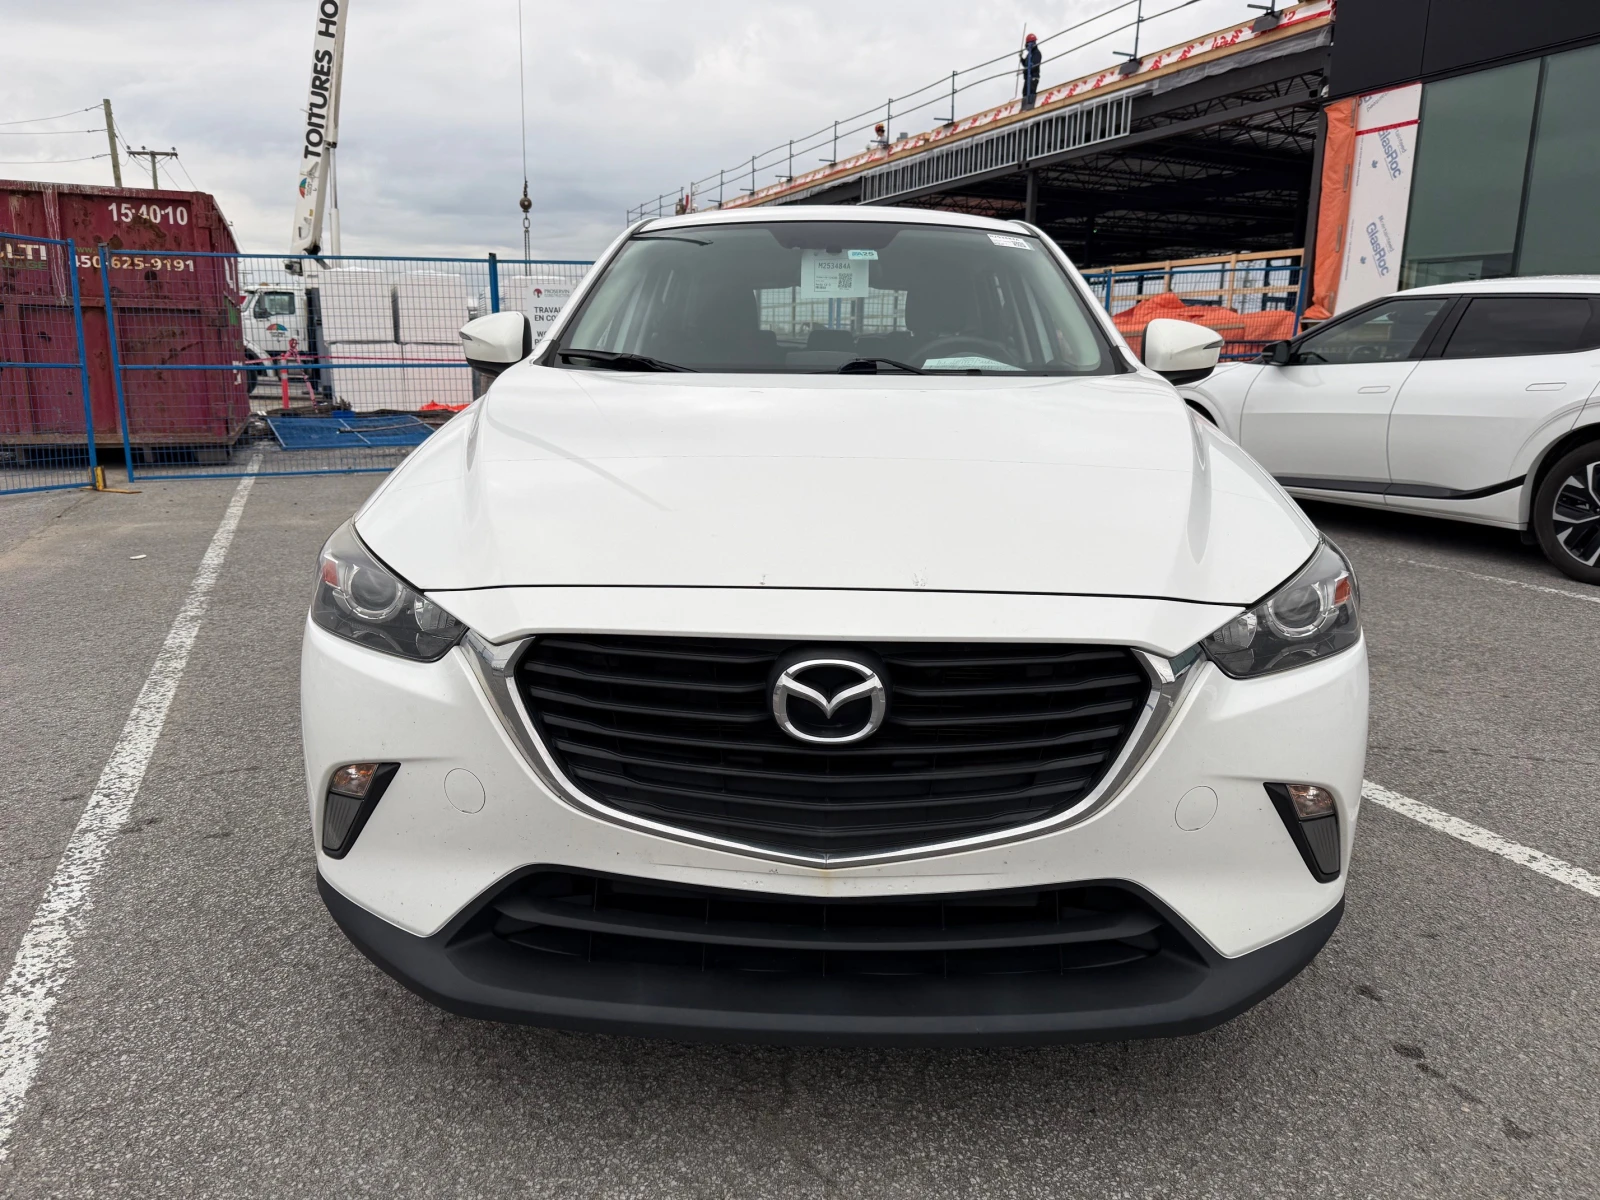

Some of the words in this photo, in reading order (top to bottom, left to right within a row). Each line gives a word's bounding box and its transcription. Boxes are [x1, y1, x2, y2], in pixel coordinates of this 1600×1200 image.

[304, 49, 333, 159] TOITURES
[0, 243, 47, 260] LTI
[818, 262, 851, 270] M253484A
[1366, 222, 1389, 276] GlasRoc
